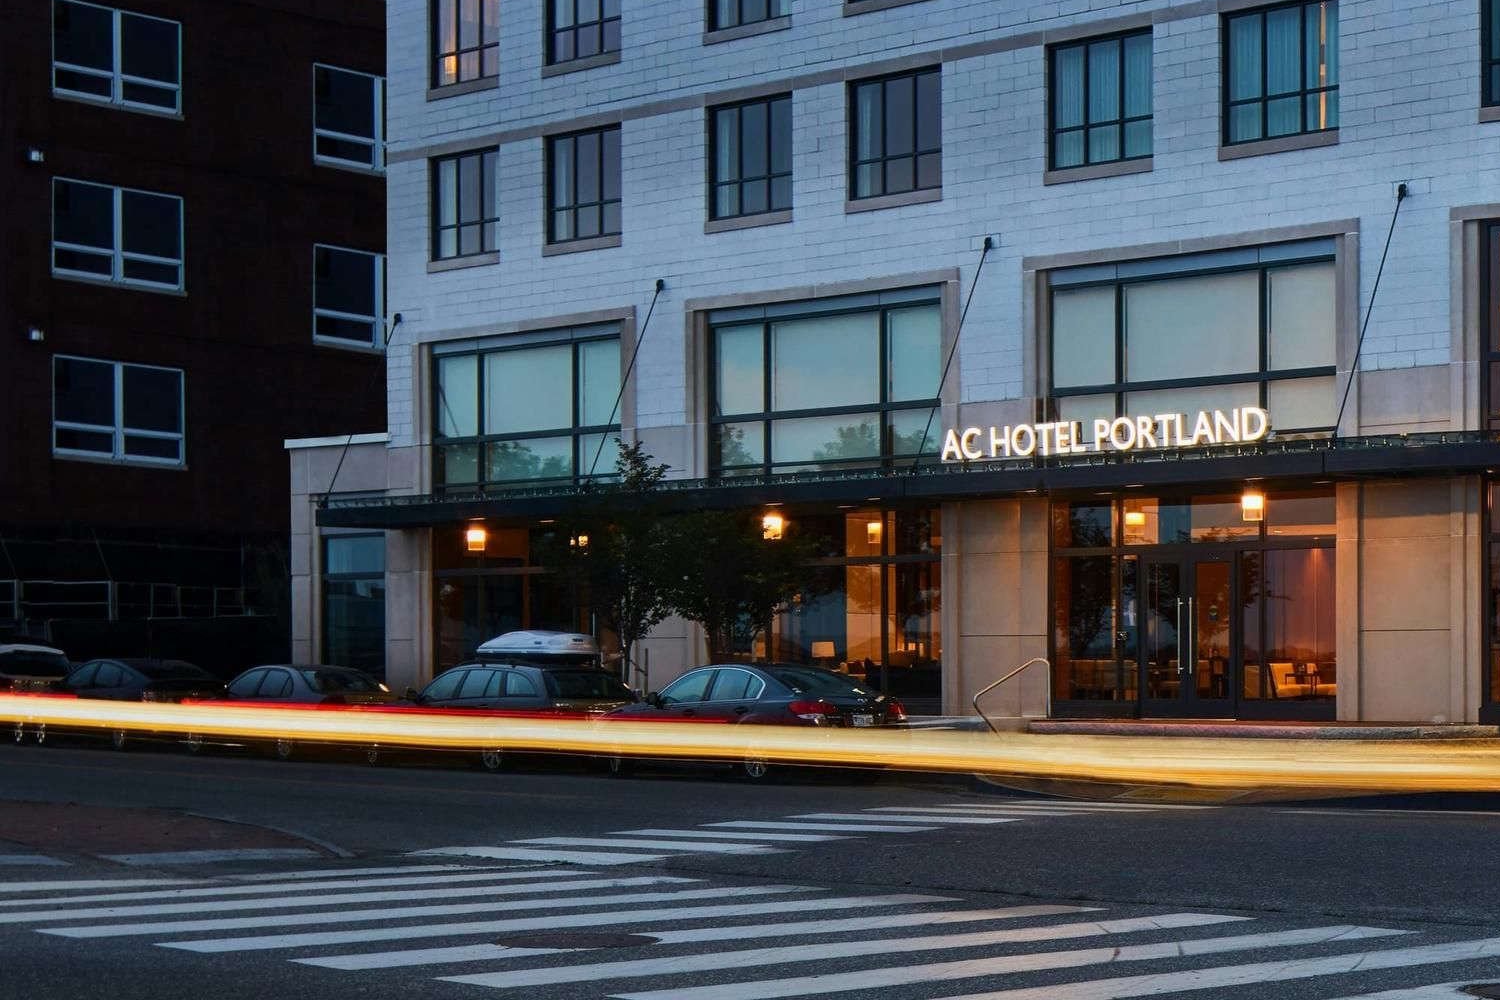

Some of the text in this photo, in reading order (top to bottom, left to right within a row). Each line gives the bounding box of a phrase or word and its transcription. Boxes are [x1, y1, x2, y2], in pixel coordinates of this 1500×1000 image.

[941, 407, 1269, 461] AC HOTEL PORTLAND
